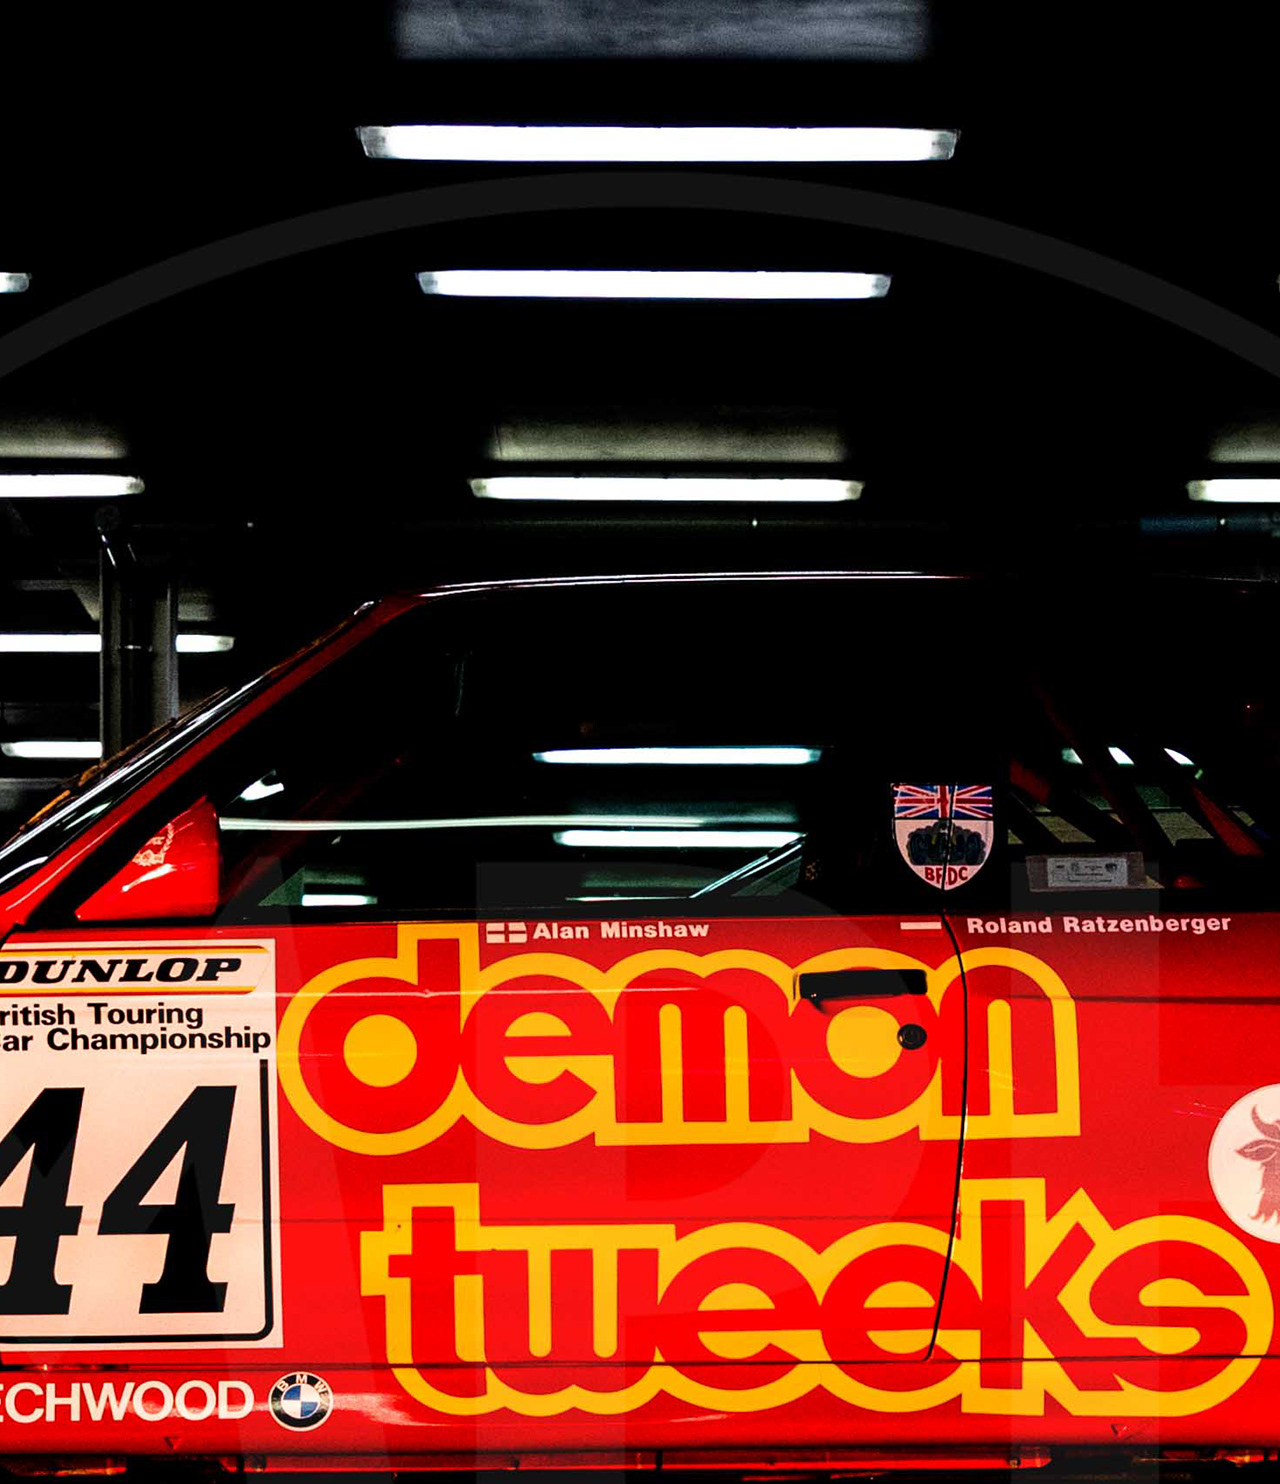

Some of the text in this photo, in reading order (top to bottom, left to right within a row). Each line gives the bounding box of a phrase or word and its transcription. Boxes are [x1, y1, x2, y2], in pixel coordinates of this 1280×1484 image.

[532, 921, 710, 940] Alan Minshaw
[966, 915, 1232, 935] Roland Ratzenberger
[87, 1002, 204, 1029] Touring
[46, 1025, 272, 1054] Championship
[277, 921, 1081, 1156] demon
[360, 1176, 1274, 1416] tweeks
